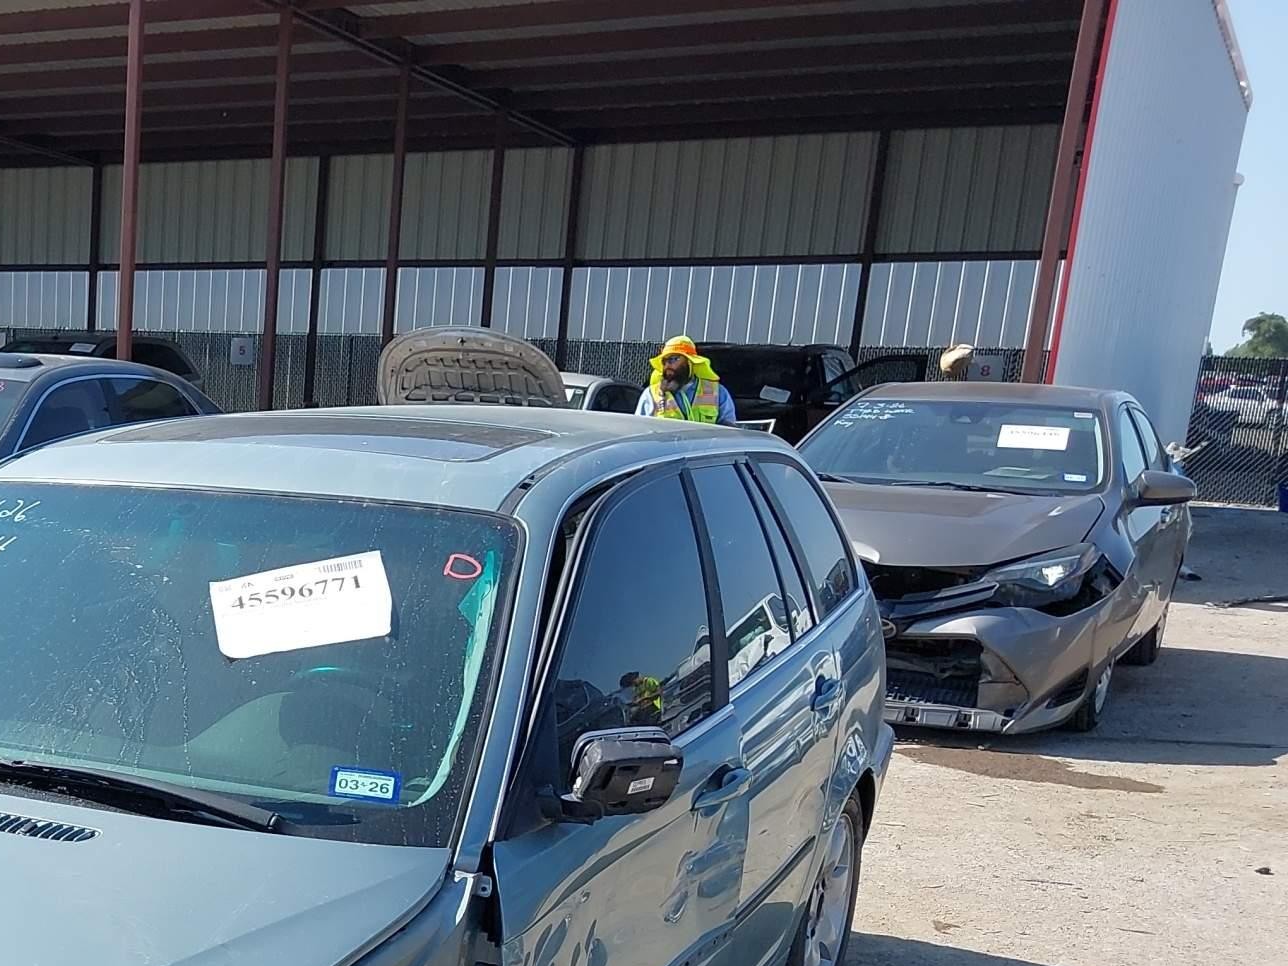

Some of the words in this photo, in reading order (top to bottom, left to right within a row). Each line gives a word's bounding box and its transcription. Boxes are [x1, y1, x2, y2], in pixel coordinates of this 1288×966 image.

[239, 345, 247, 356] 5
[980, 365, 991, 377] 8
[230, 575, 362, 610] 45596771
